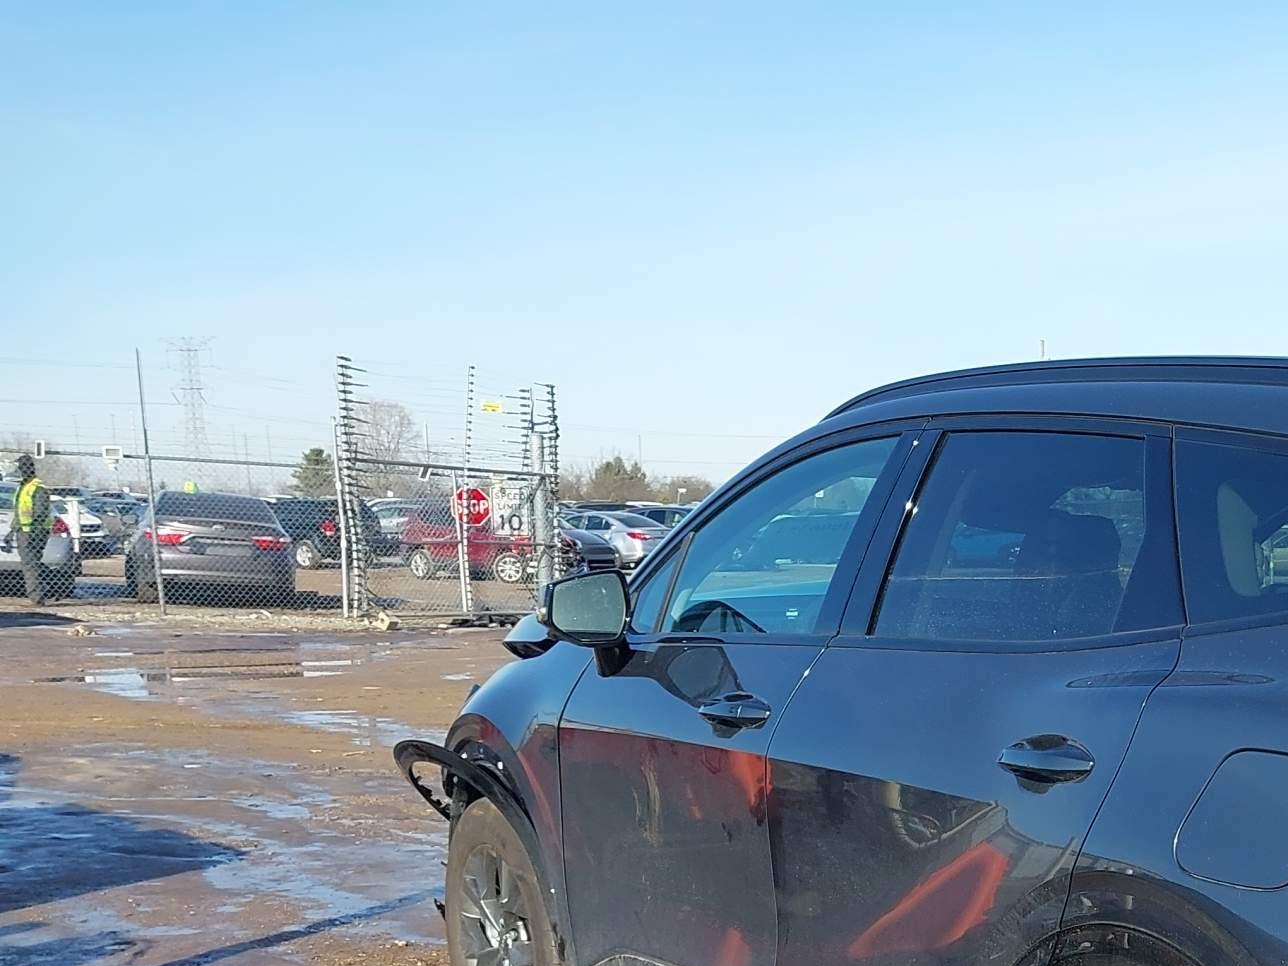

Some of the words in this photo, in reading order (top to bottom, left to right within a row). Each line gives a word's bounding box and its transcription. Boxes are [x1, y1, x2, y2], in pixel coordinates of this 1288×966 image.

[494, 491, 526, 501] SPEED
[457, 499, 489, 515] SOP
[496, 502, 522, 511] LIMIT
[499, 513, 523, 531] 10
